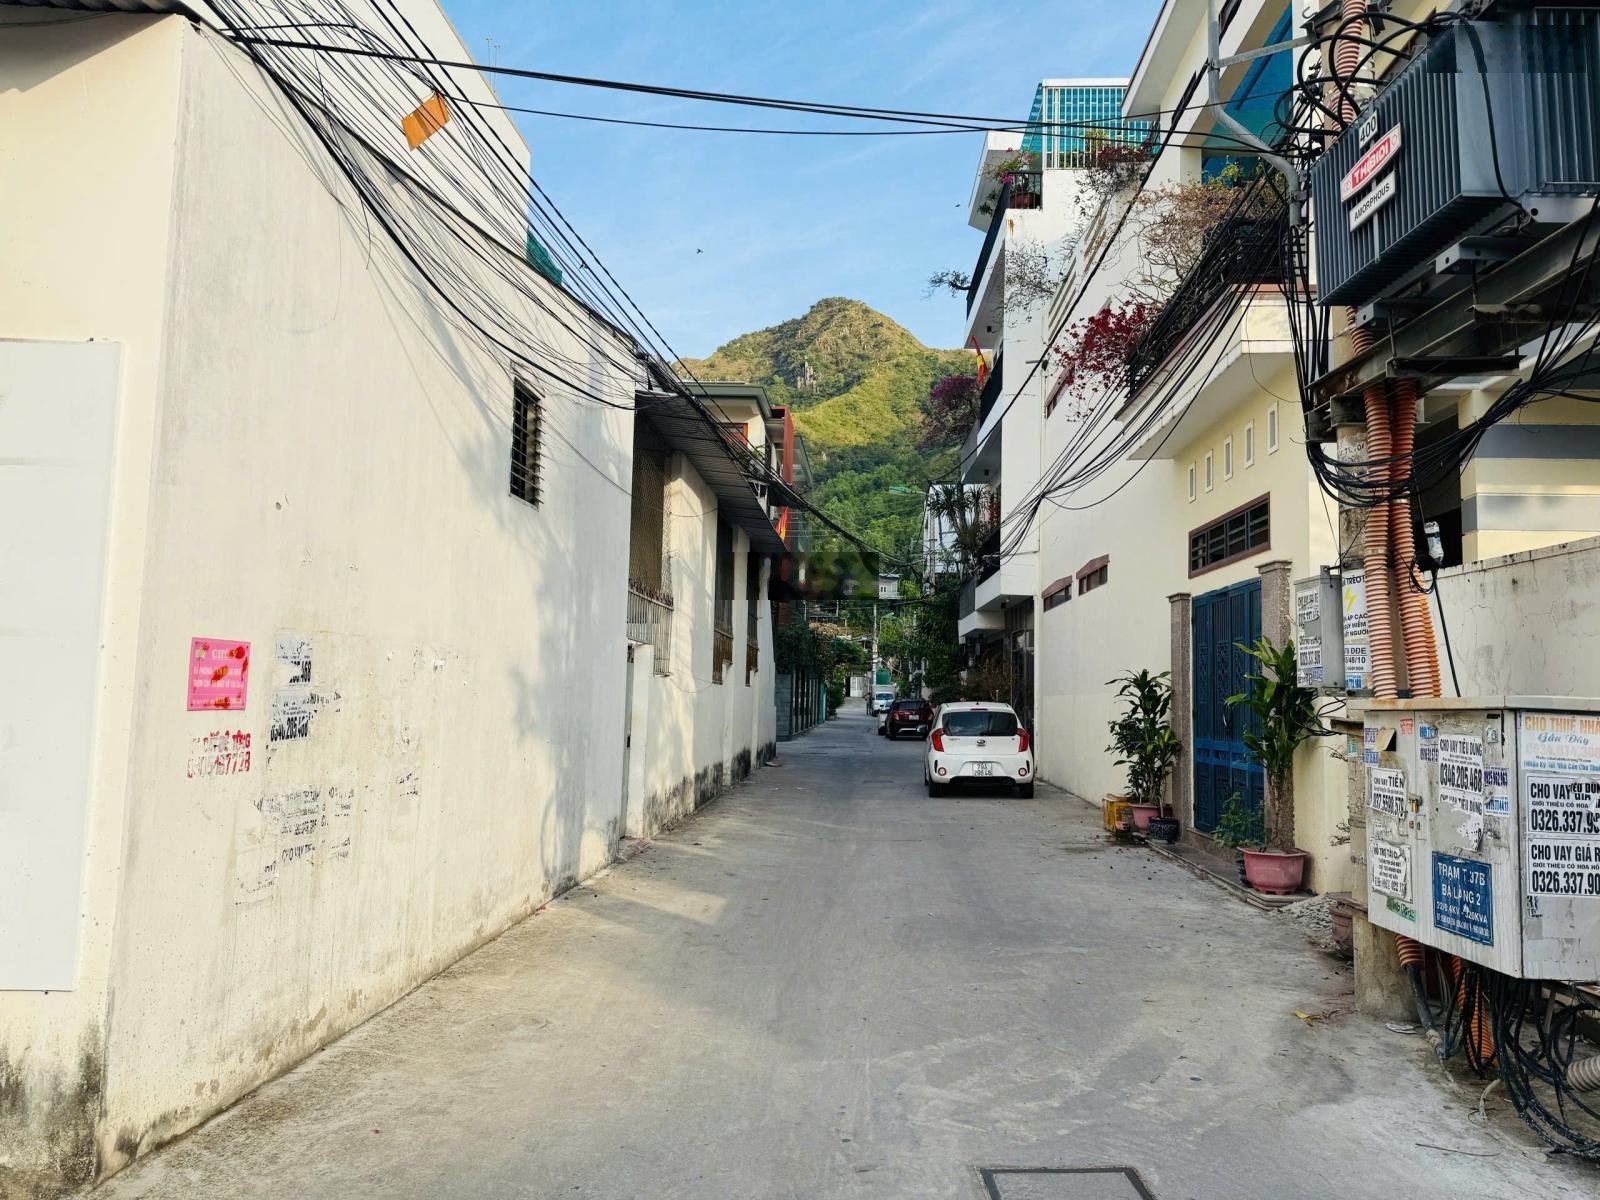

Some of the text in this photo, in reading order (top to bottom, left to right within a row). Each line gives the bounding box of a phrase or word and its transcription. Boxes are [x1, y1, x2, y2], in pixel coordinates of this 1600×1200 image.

[1360, 116, 1376, 143] 400
[1353, 139, 1390, 184] THIBIDI
[1354, 182, 1390, 222] AMORPHOUS
[1525, 715, 1546, 731] CHO
[1440, 762, 1483, 793] 0346.205.468
[1531, 782, 1550, 799] CHO
[1553, 784, 1570, 800] VAY
[1531, 844, 1551, 860] CHO
[1553, 845, 1572, 861] VAY
[1575, 843, 1592, 863] GIÁ
[1532, 870, 1600, 895] 0326.337.90
[1476, 894, 1481, 906] 2
